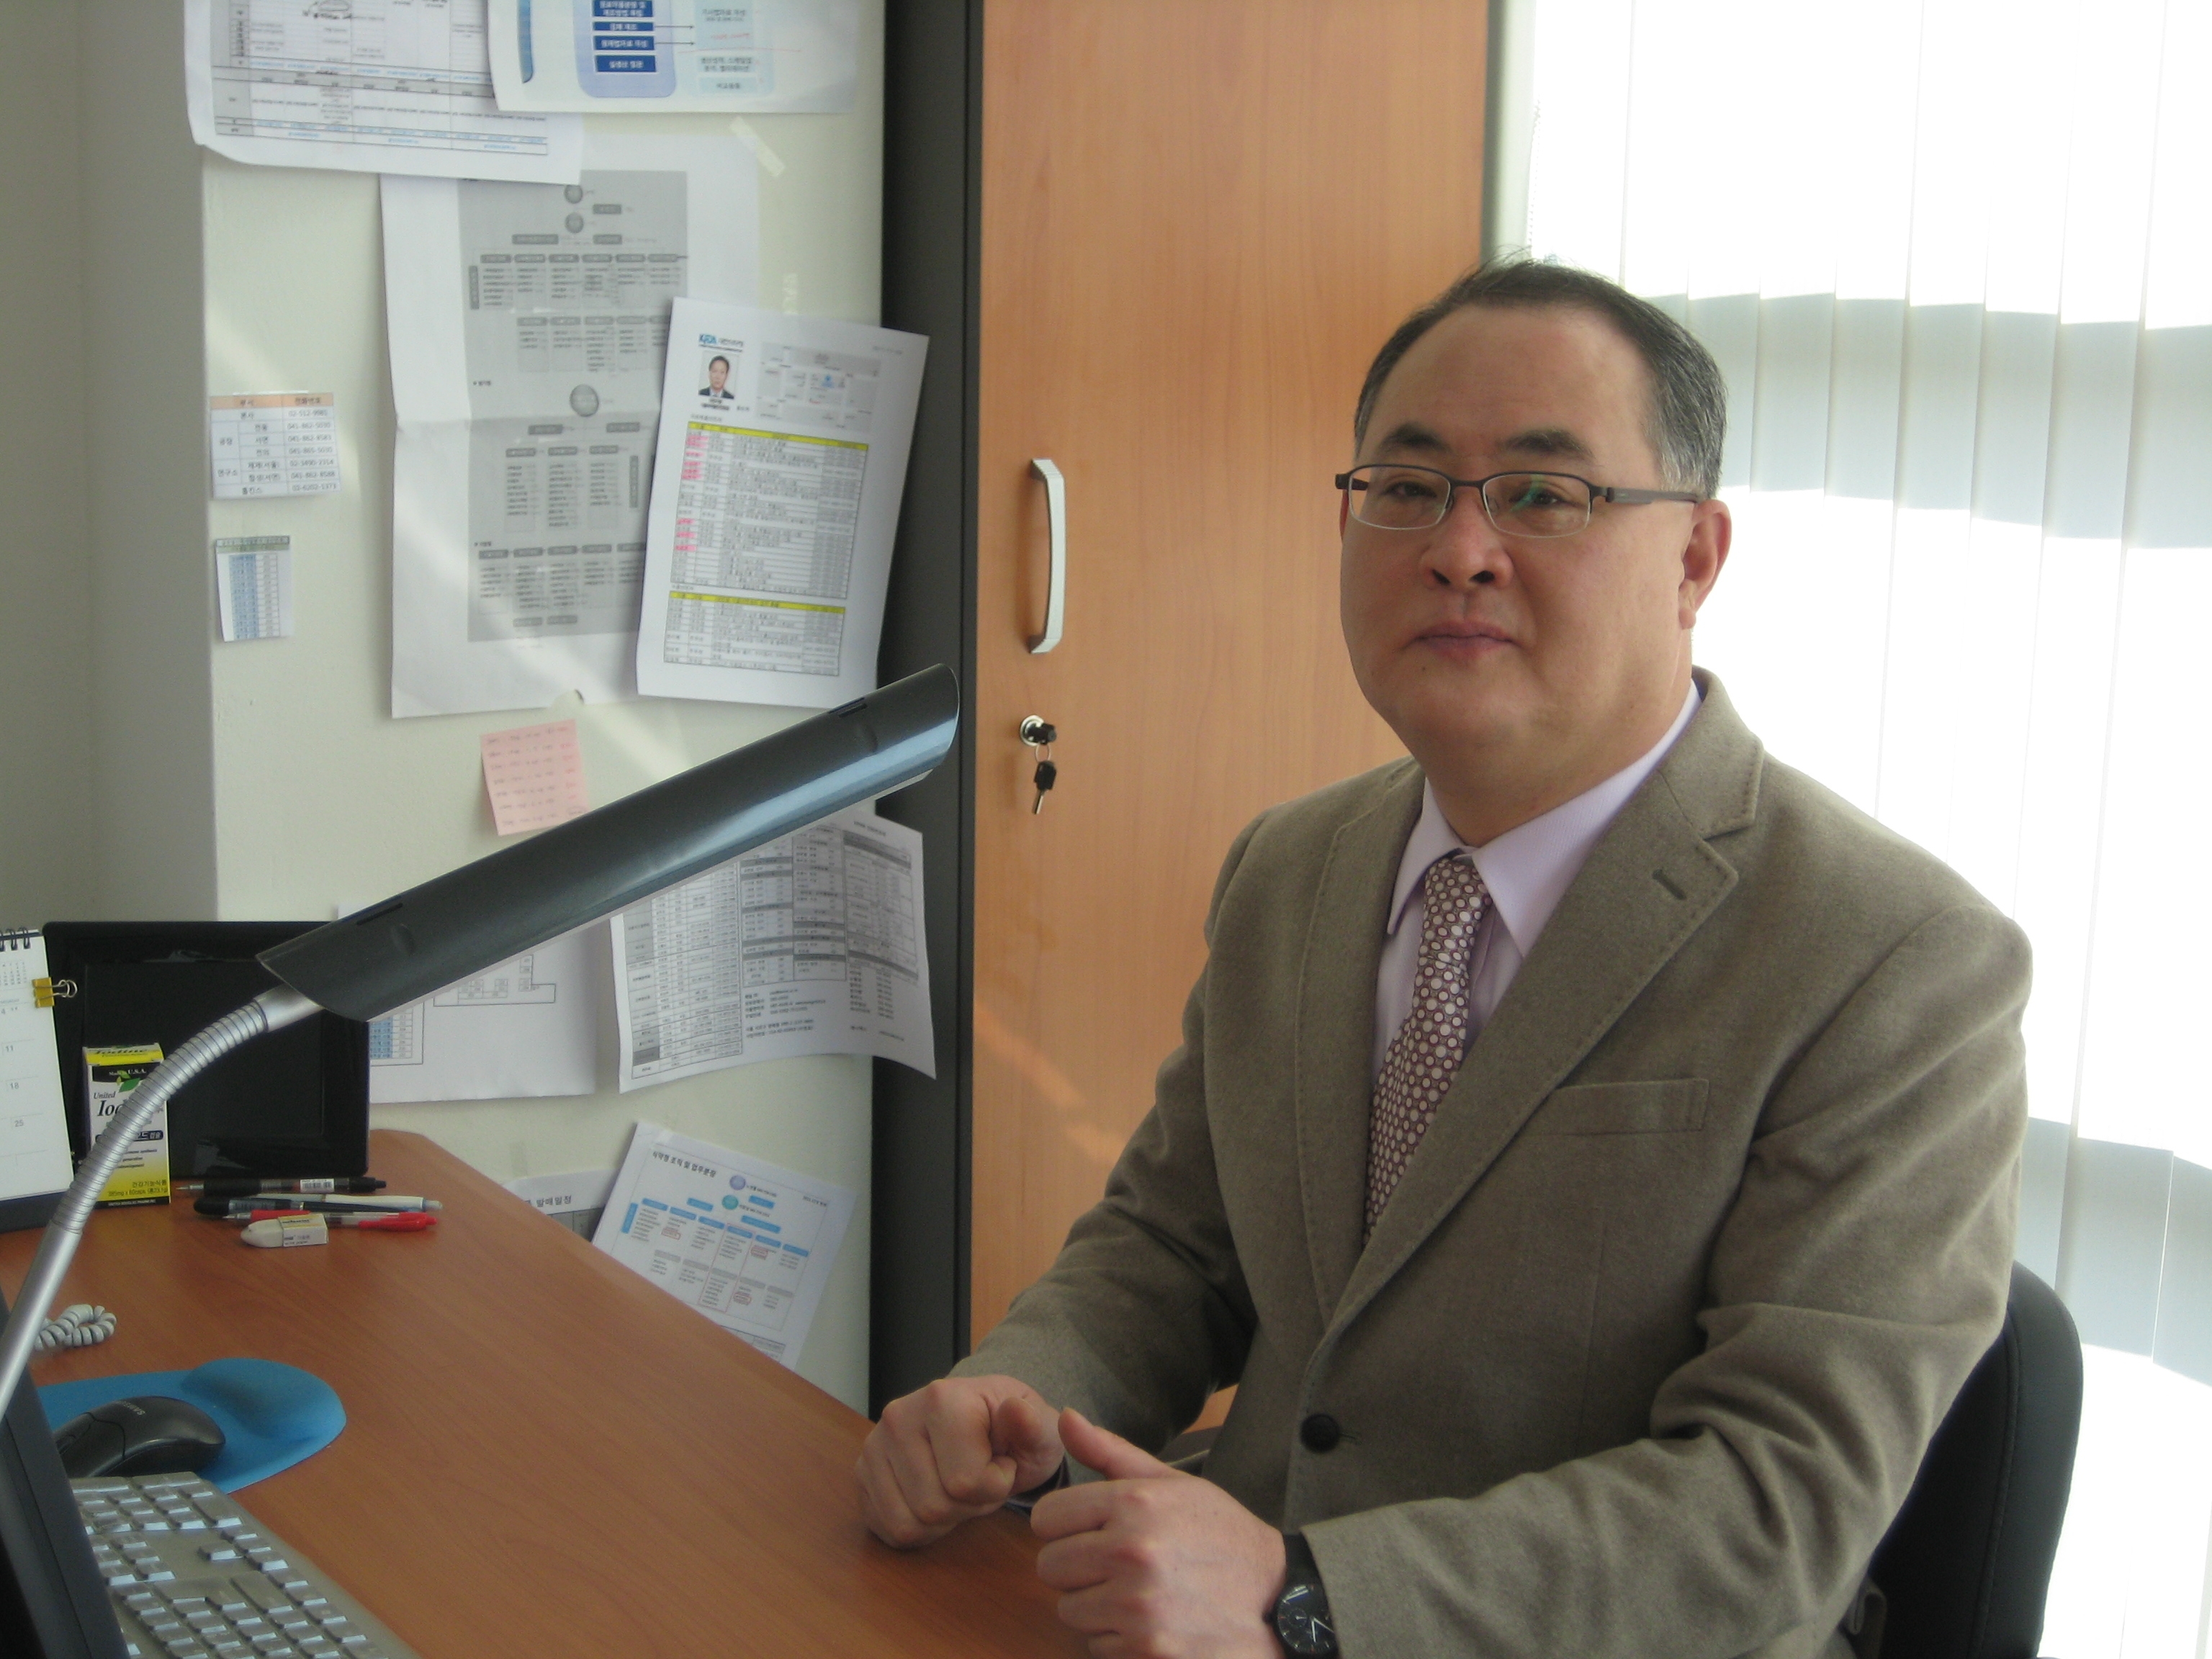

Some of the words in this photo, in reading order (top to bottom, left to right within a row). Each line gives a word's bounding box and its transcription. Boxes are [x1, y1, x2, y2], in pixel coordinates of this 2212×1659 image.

[93, 1091, 116, 1100] United
[14, 1119, 24, 1128] 25
[536, 1195, 572, 1208] 발매일정
